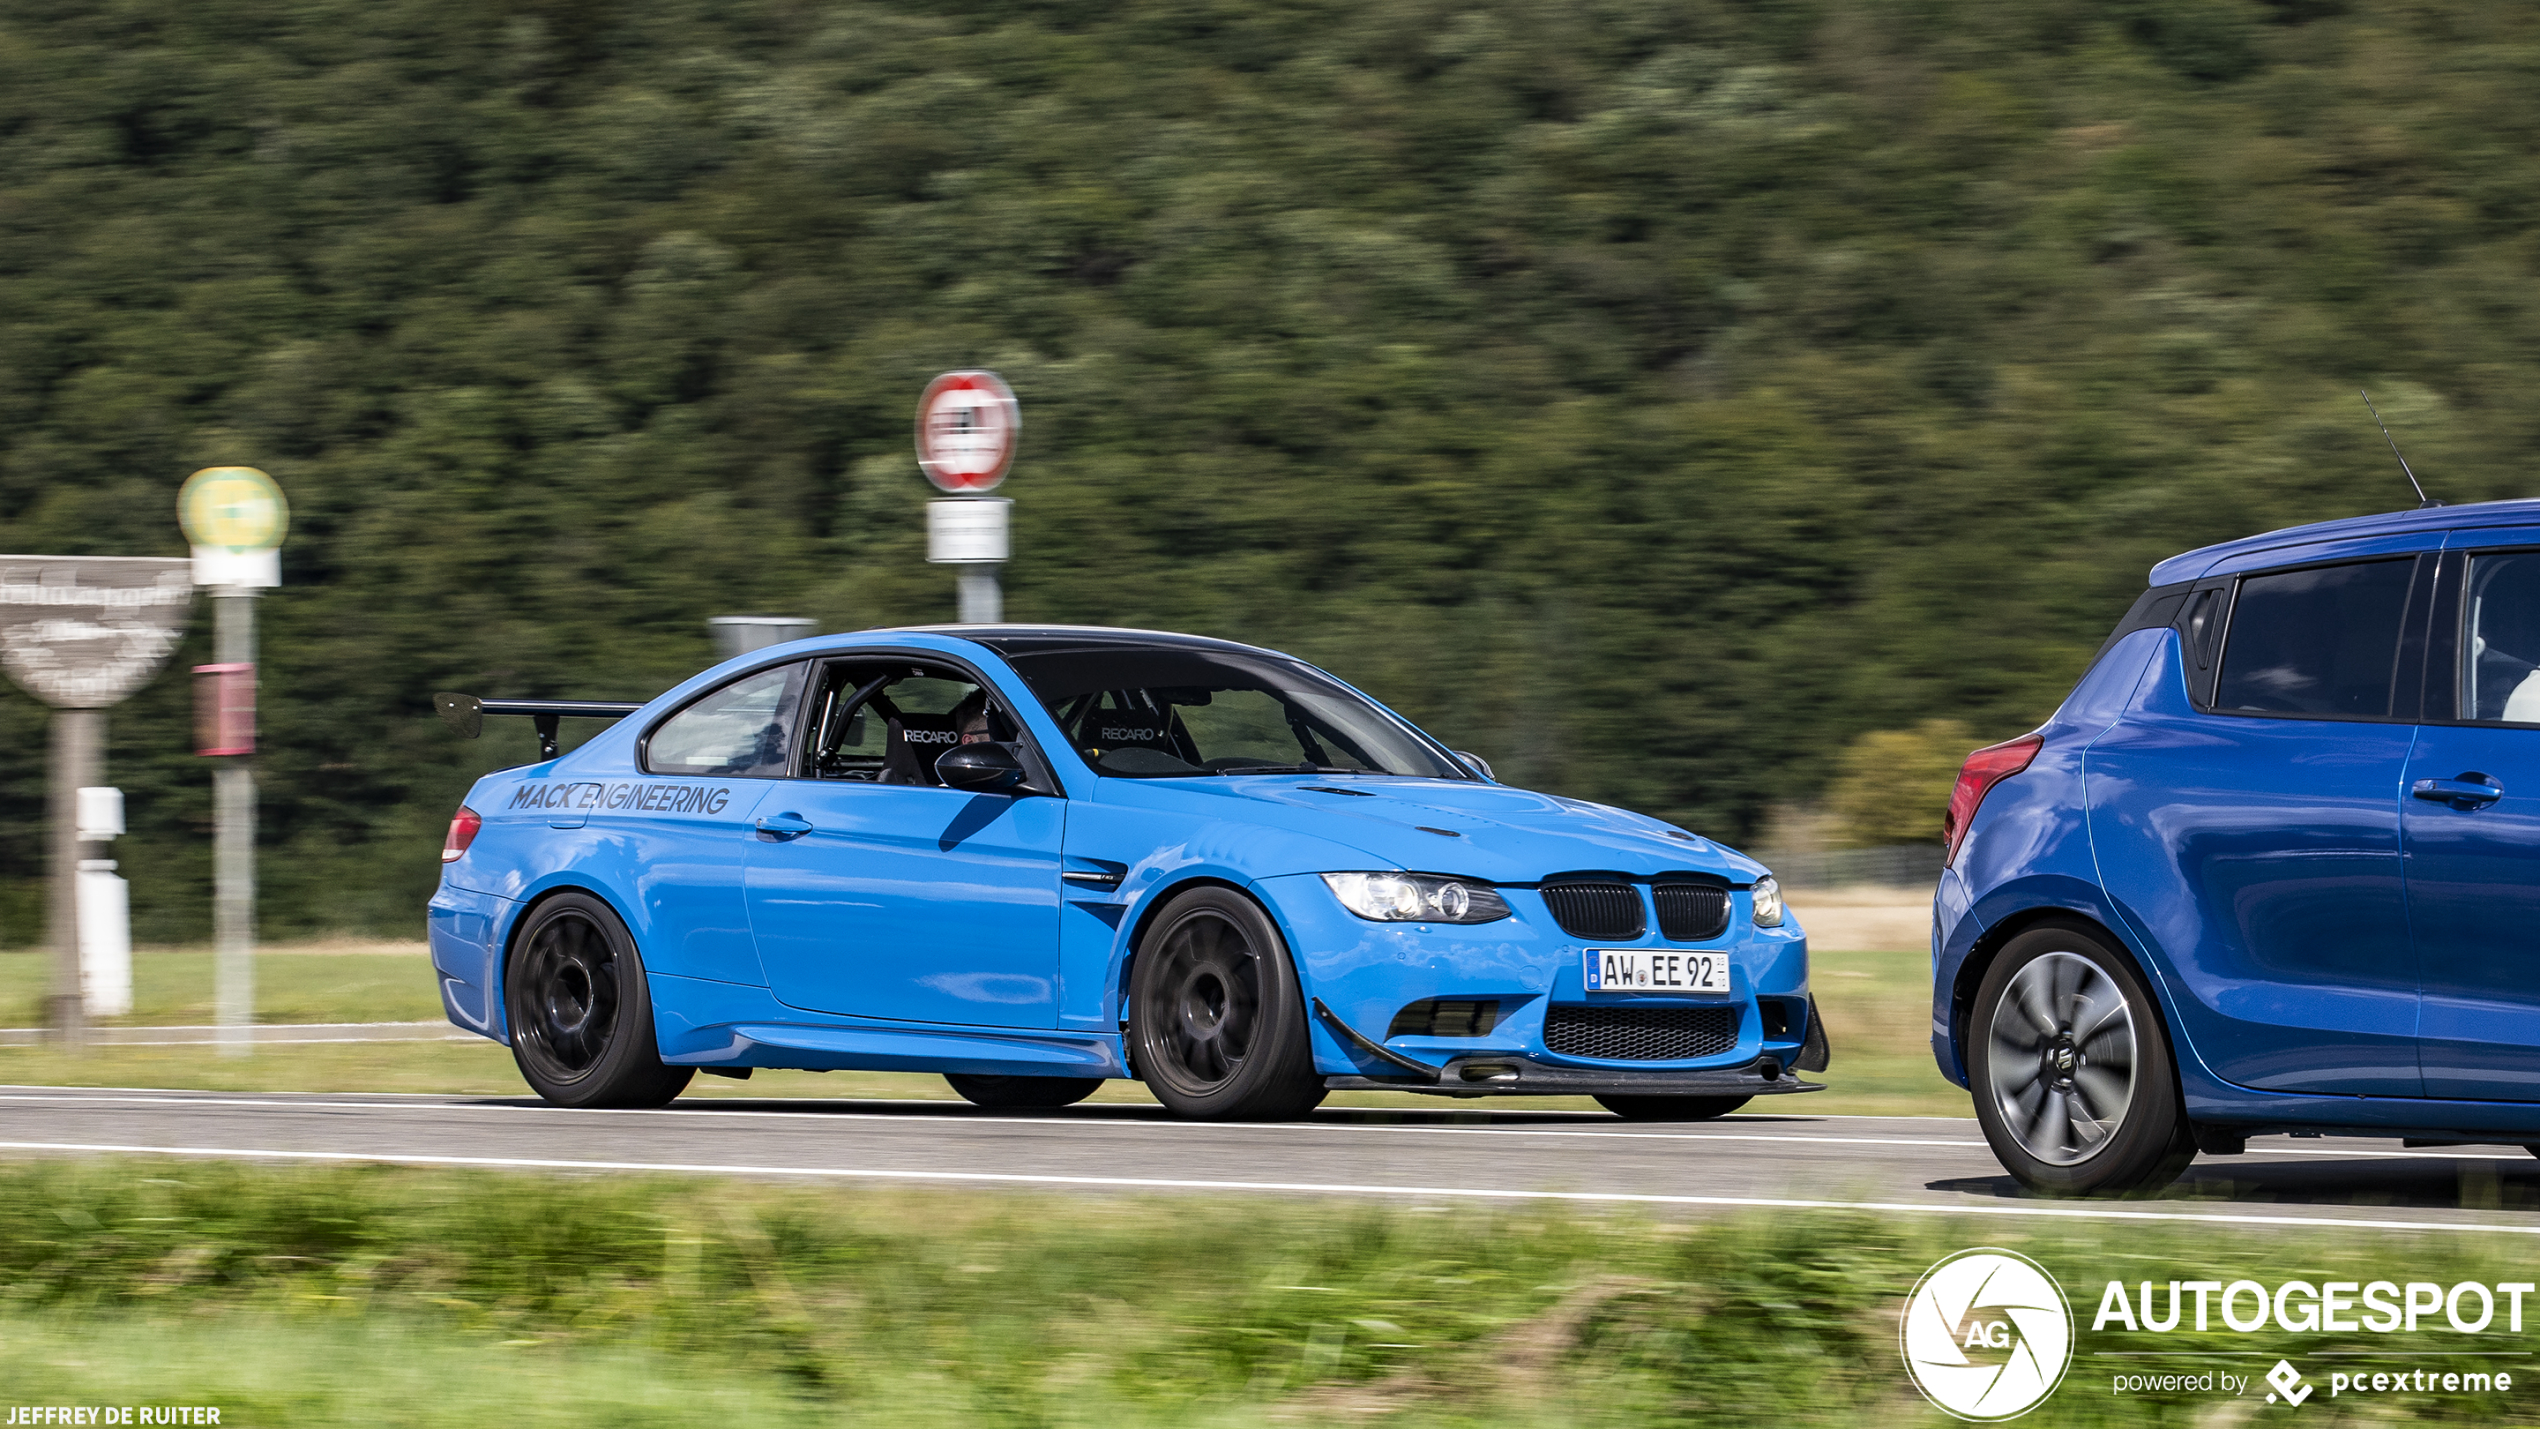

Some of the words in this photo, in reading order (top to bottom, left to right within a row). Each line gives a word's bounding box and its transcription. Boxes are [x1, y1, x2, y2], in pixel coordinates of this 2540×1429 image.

[903, 729, 958, 744] RECARO
[1101, 727, 1154, 741] RECARO
[508, 784, 582, 809] MACK
[576, 783, 731, 815] ENGINEERING
[1604, 955, 1634, 985] AW
[1653, 955, 1682, 986] EE
[1687, 956, 1713, 987] 92
